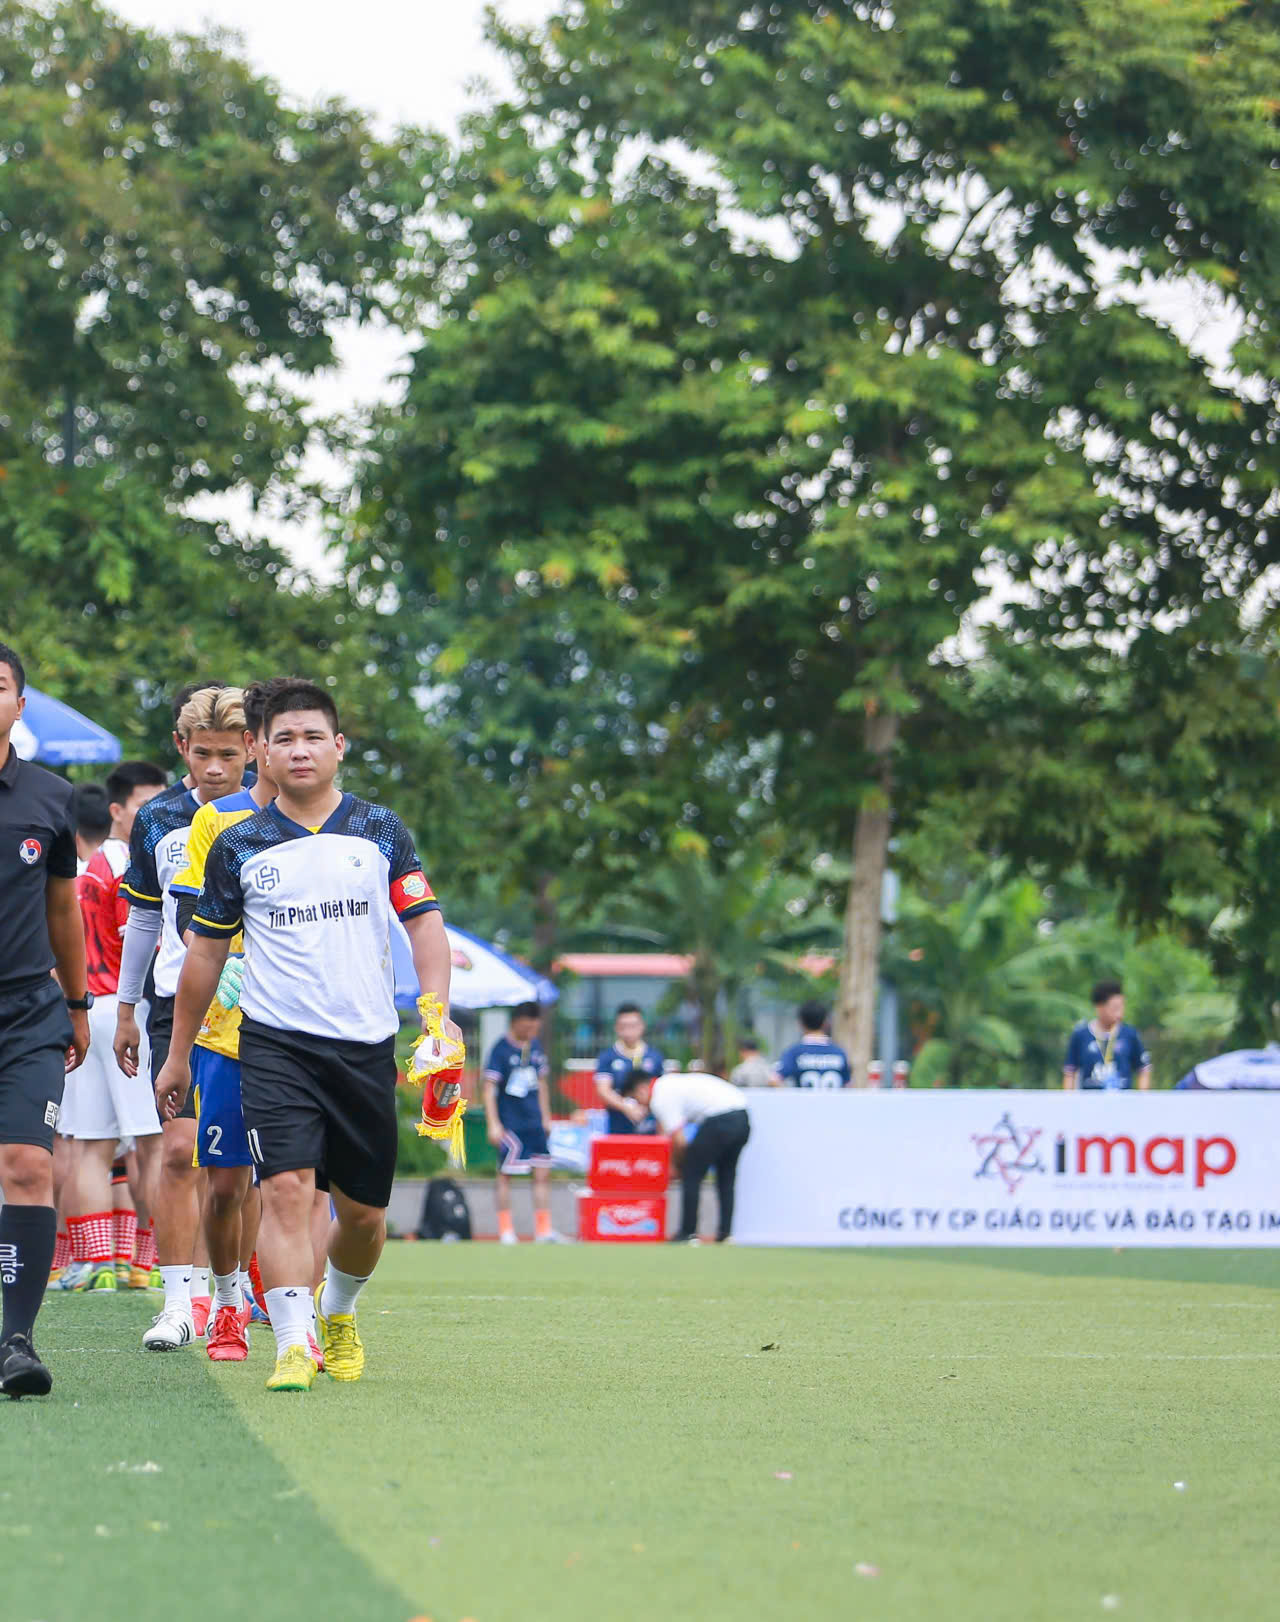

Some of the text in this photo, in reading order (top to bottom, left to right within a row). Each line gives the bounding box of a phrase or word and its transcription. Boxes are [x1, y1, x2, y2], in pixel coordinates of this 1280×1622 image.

[288, 905, 318, 925] Phát
[320, 899, 345, 922] Việt
[347, 898, 369, 917] Nam
[206, 1125, 223, 1156] 2
[1055, 1133, 1237, 1188] imap
[838, 1206, 904, 1230] CÔNG
[914, 1209, 939, 1229] TY
[948, 1211, 978, 1229] CP
[984, 1207, 1042, 1230] GIÁO
